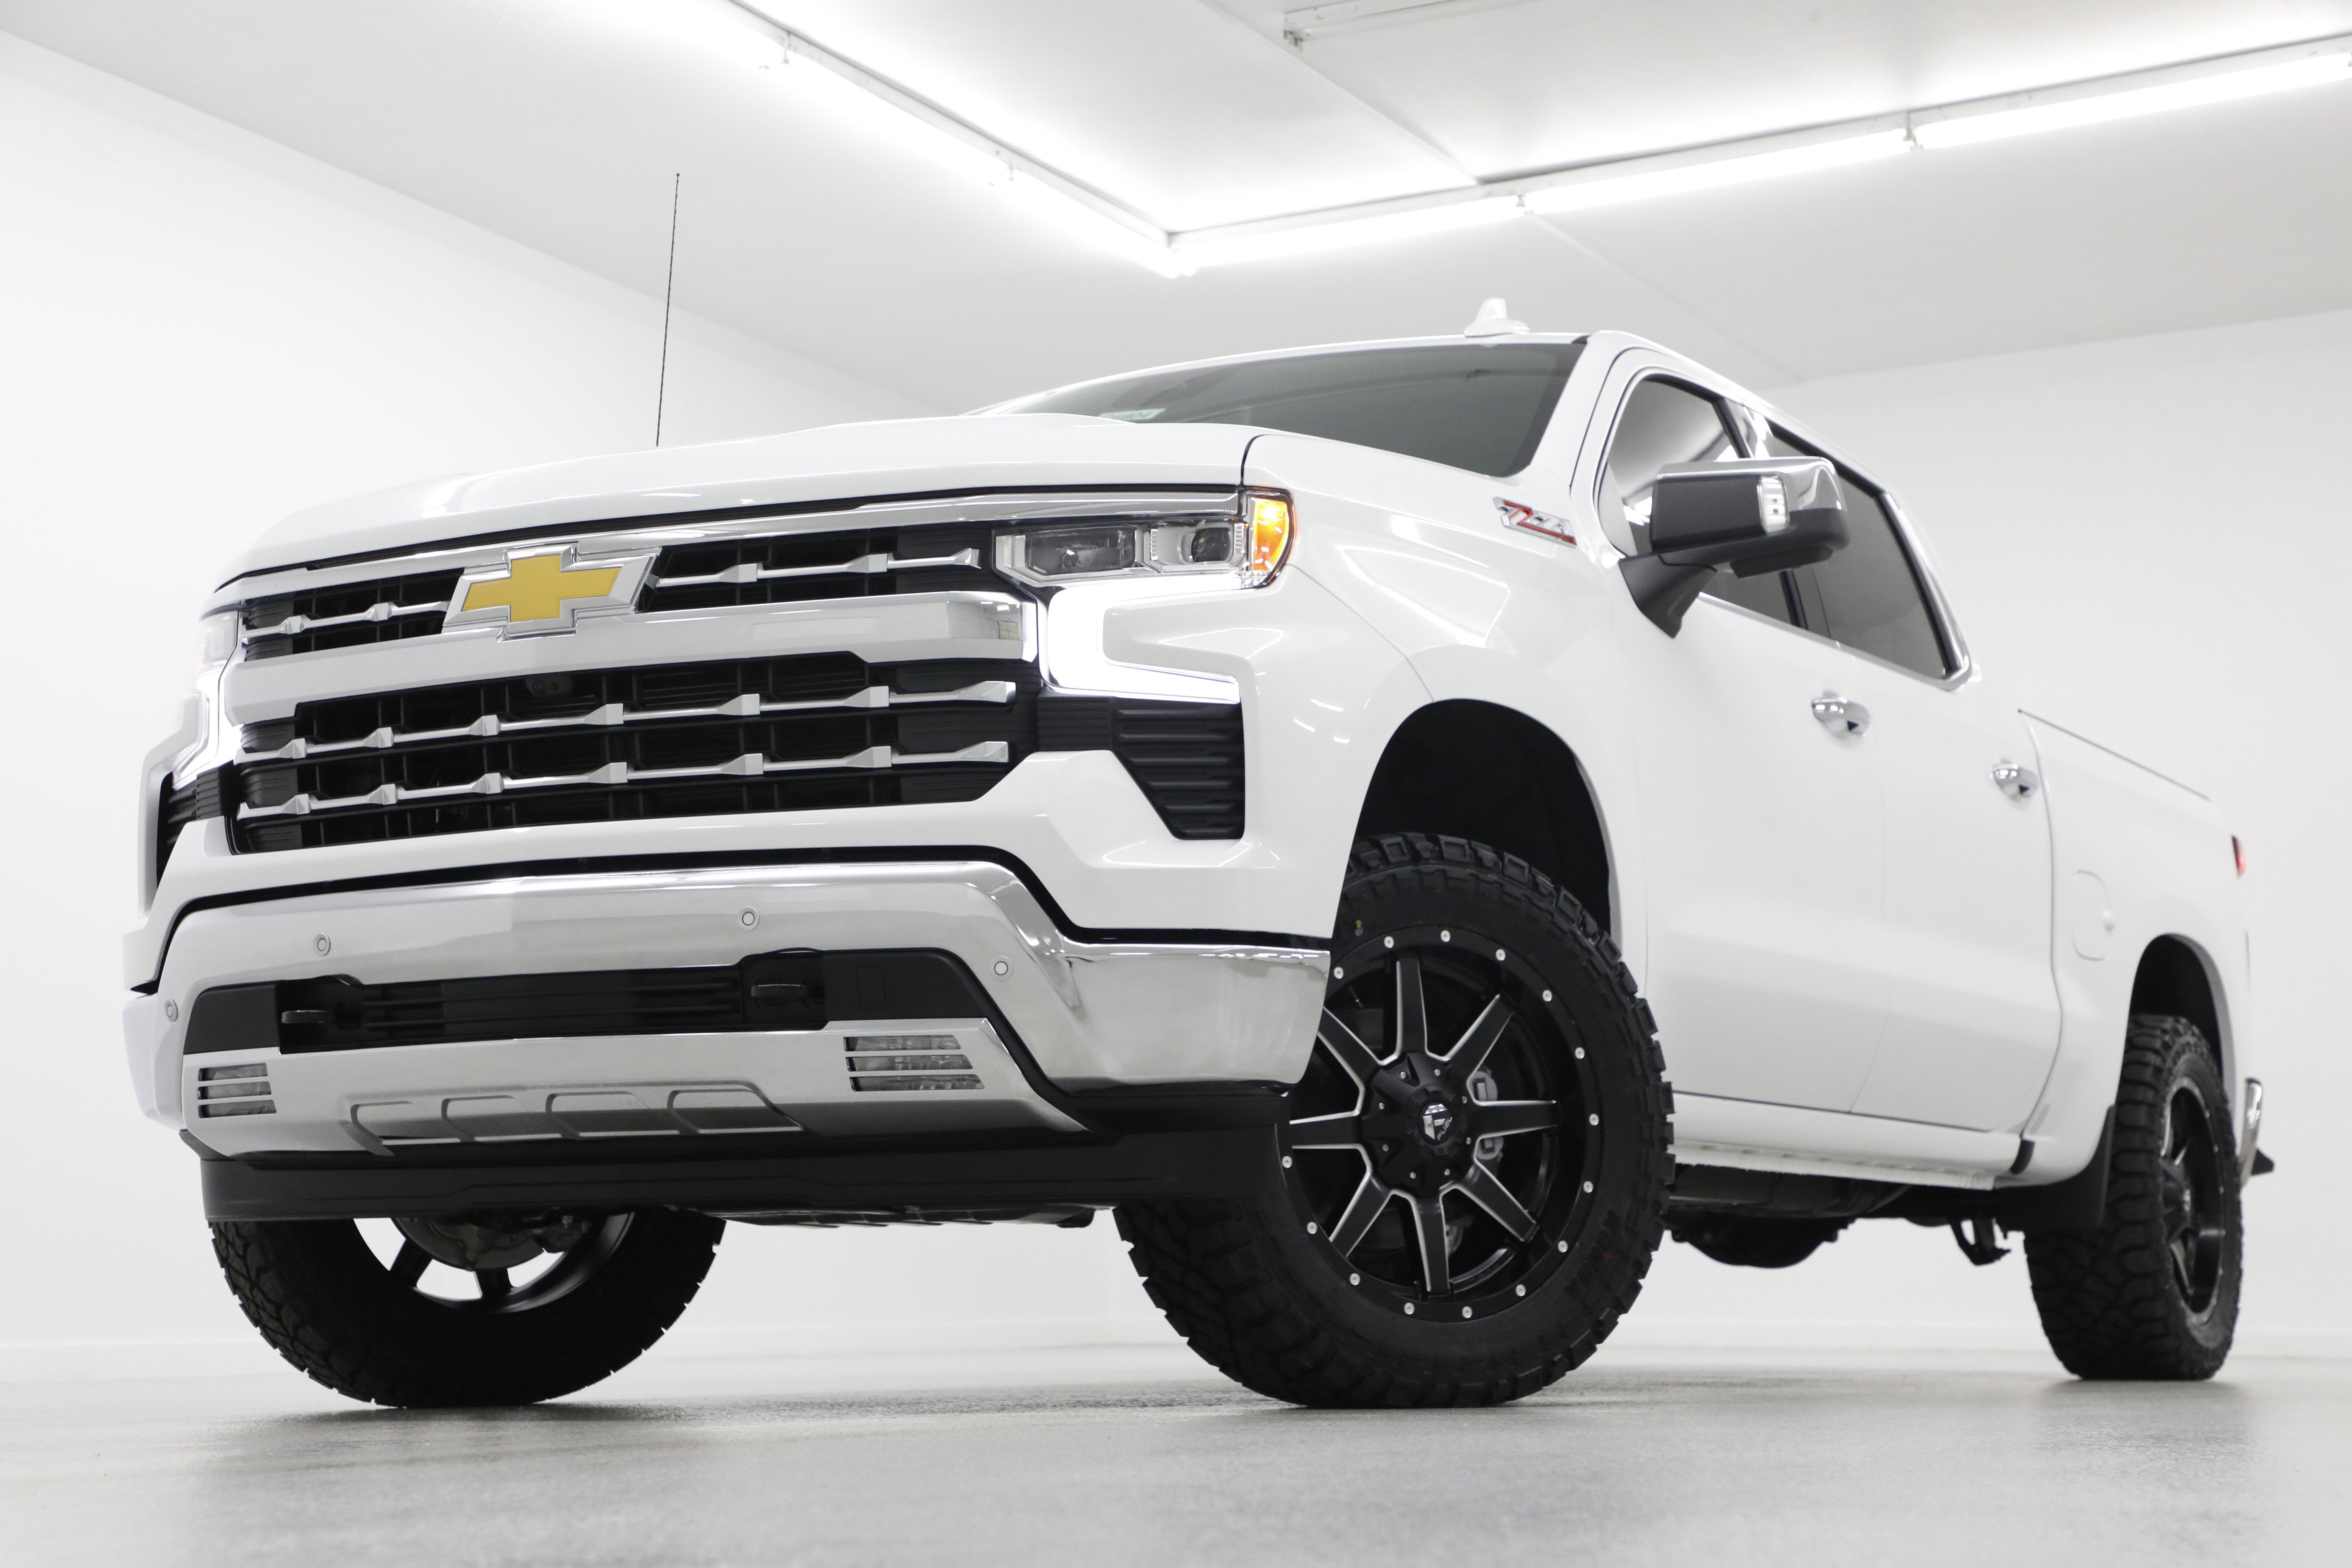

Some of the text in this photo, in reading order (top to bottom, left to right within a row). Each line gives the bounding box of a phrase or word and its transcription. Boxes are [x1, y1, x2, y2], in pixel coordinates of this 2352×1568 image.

[1493, 496, 1577, 548] Z71
[1437, 1117, 1453, 1140] FUEL
[1564, 1208, 1622, 1299] KENDA
